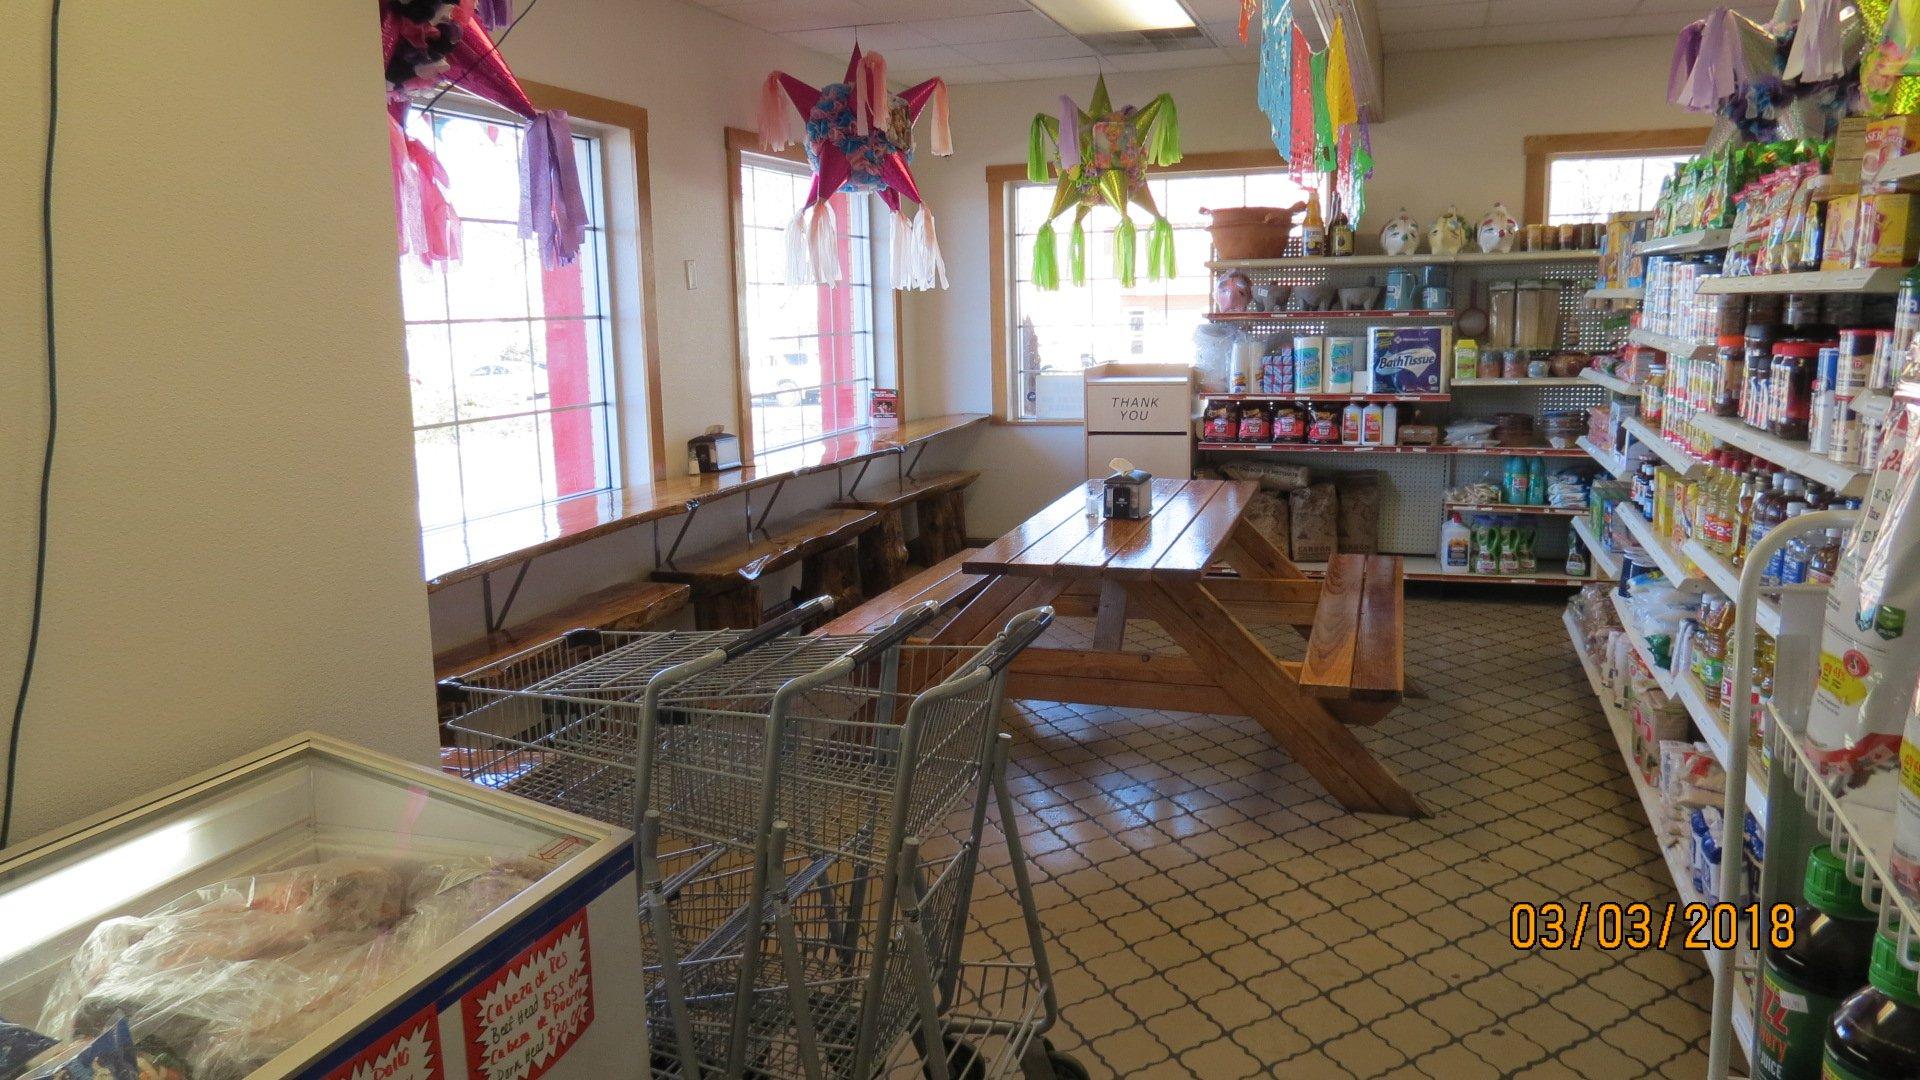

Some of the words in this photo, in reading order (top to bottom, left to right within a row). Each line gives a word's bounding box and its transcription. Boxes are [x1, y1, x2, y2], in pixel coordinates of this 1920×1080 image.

[1112, 397, 1160, 408] THANK
[1120, 410, 1149, 421] YOU
[487, 982, 533, 1023] Cabeza
[535, 970, 548, 988] de
